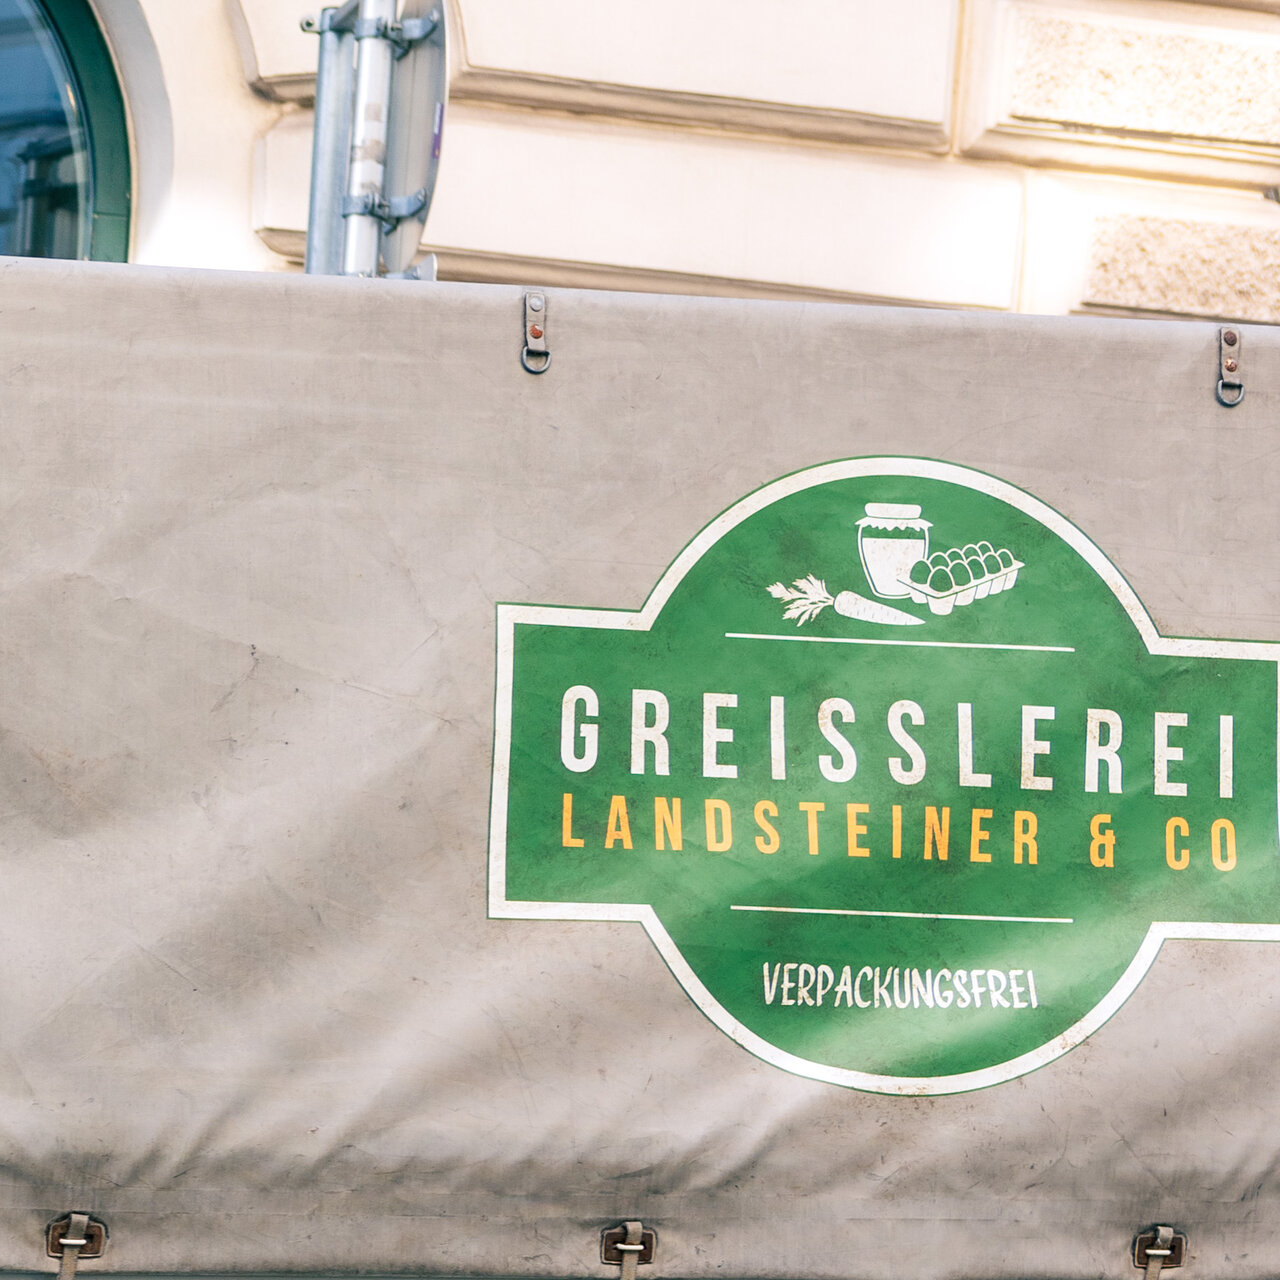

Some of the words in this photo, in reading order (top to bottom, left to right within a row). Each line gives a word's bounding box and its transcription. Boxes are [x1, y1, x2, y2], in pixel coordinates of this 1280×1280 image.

[559, 684, 1236, 800] GREISSLEREI
[561, 792, 1040, 866] LANDSTEINER
[1088, 812, 1117, 869] &
[1164, 816, 1238, 872] CO
[762, 961, 1039, 1009] VERPACKUNGSFREI
